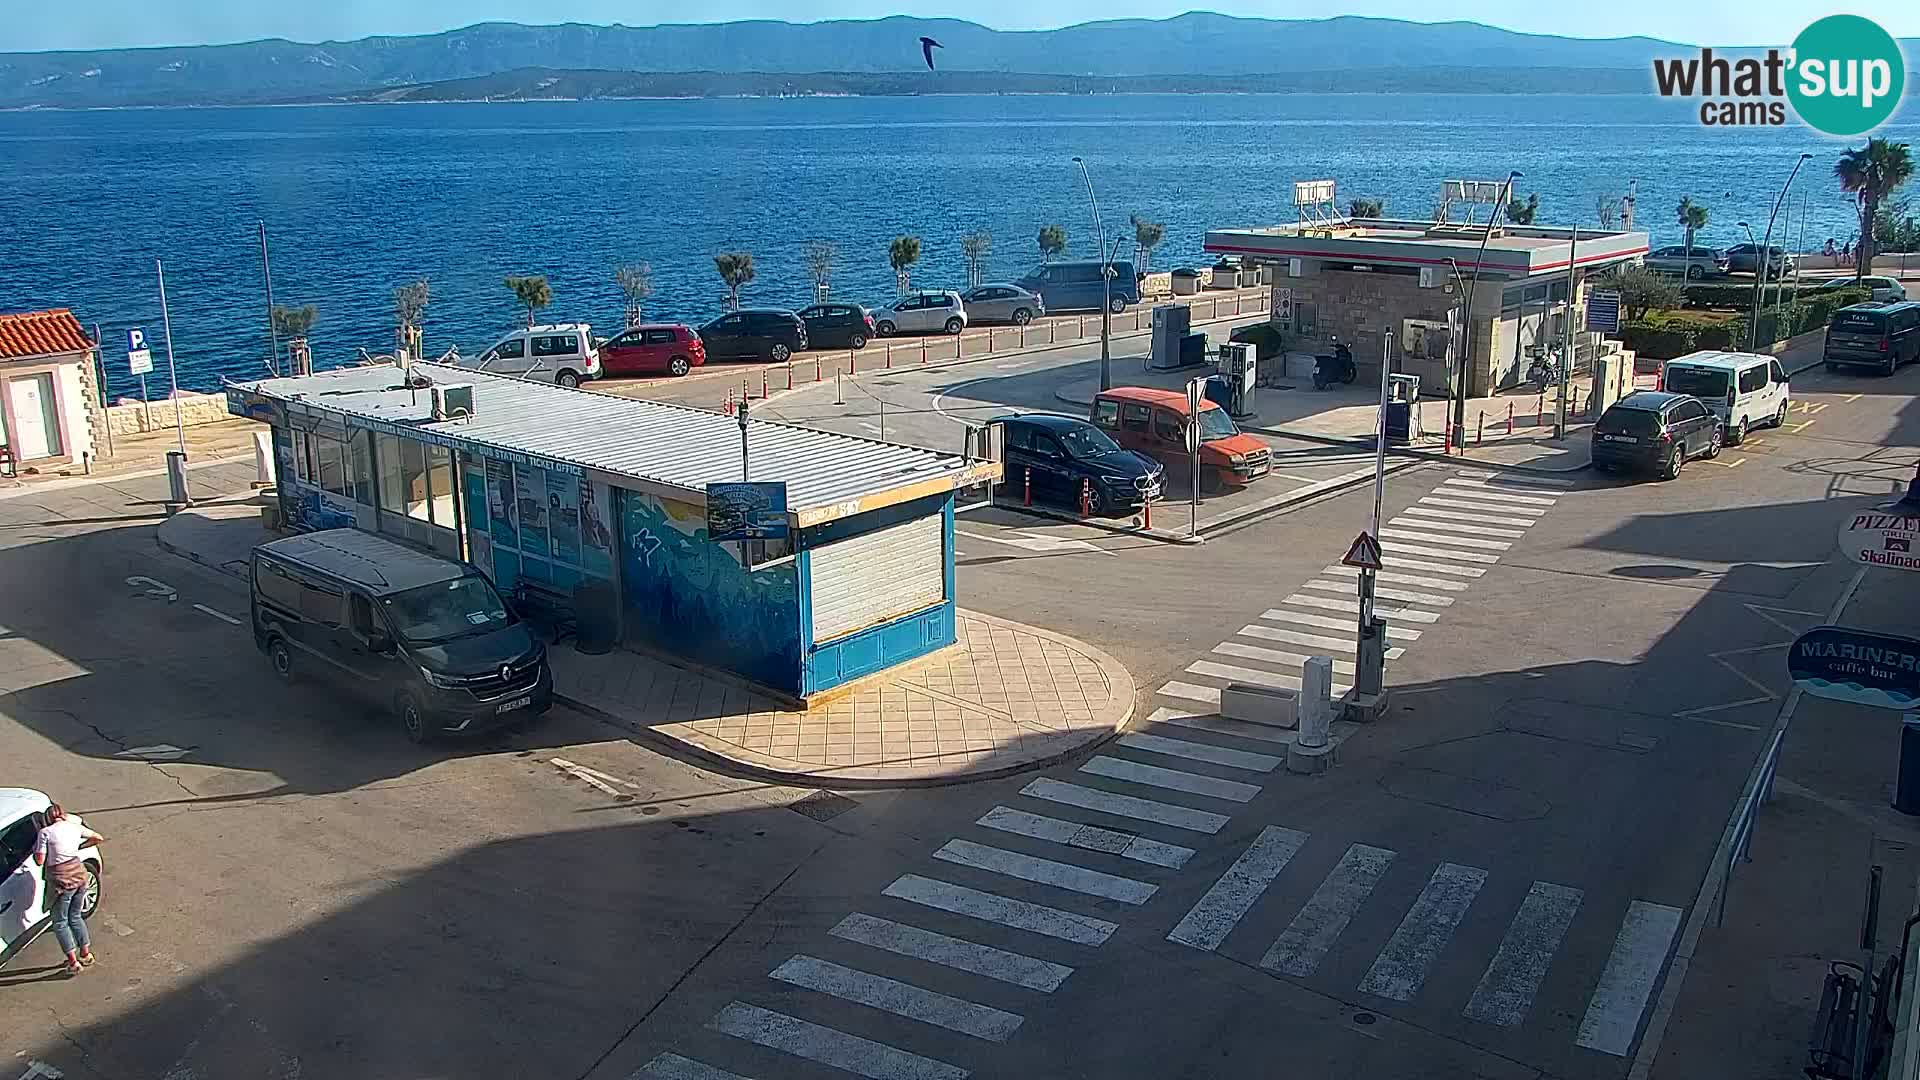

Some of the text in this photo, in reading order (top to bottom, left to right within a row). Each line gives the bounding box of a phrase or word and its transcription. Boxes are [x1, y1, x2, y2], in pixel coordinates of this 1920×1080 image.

[130, 330, 144, 350] P
[479, 445, 494, 457] BUS
[495, 449, 527, 464] STATION
[529, 457, 555, 470] TICKET
[556, 462, 583, 476] OFFICE
[1848, 515, 1920, 533] PIZZE
[1881, 529, 1917, 540] GRILL
[1870, 665, 1898, 680] bar
